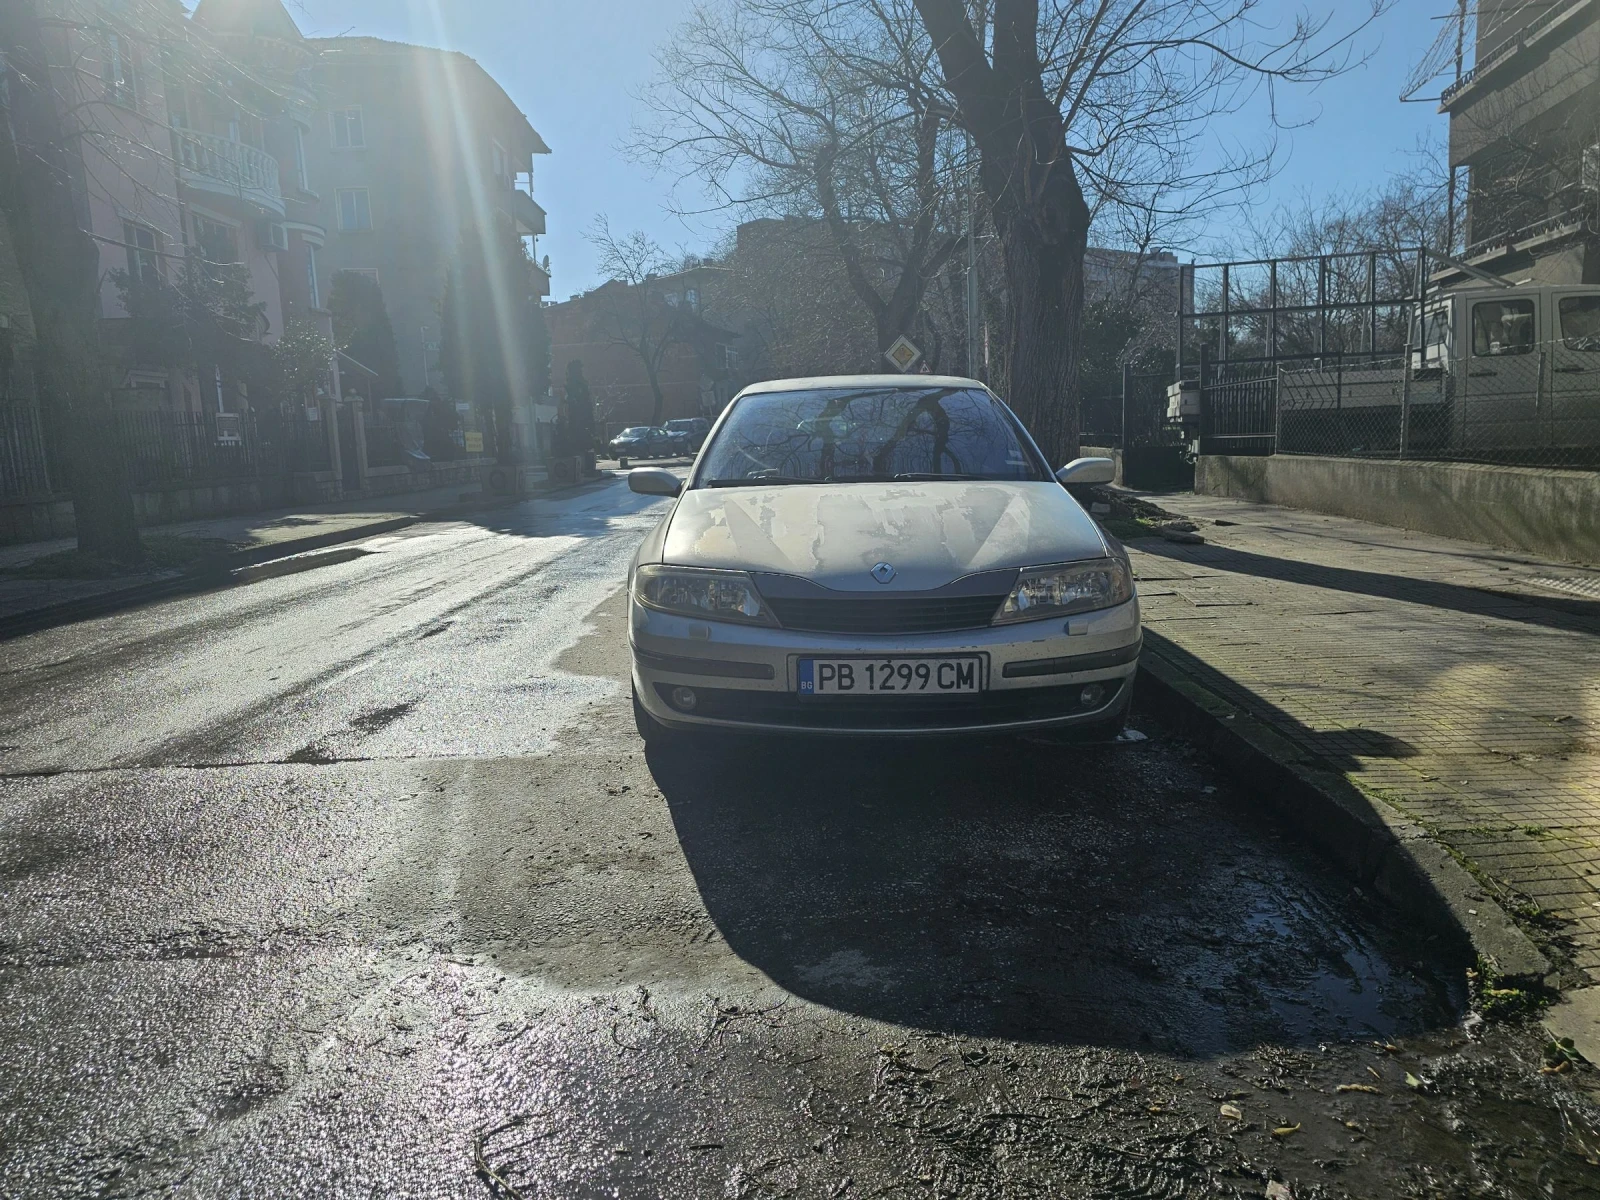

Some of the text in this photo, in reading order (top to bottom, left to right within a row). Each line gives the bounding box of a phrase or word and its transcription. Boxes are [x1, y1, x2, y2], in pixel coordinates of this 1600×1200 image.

[818, 662, 974, 690] PB 1299 CM
[801, 681, 813, 690] BG
